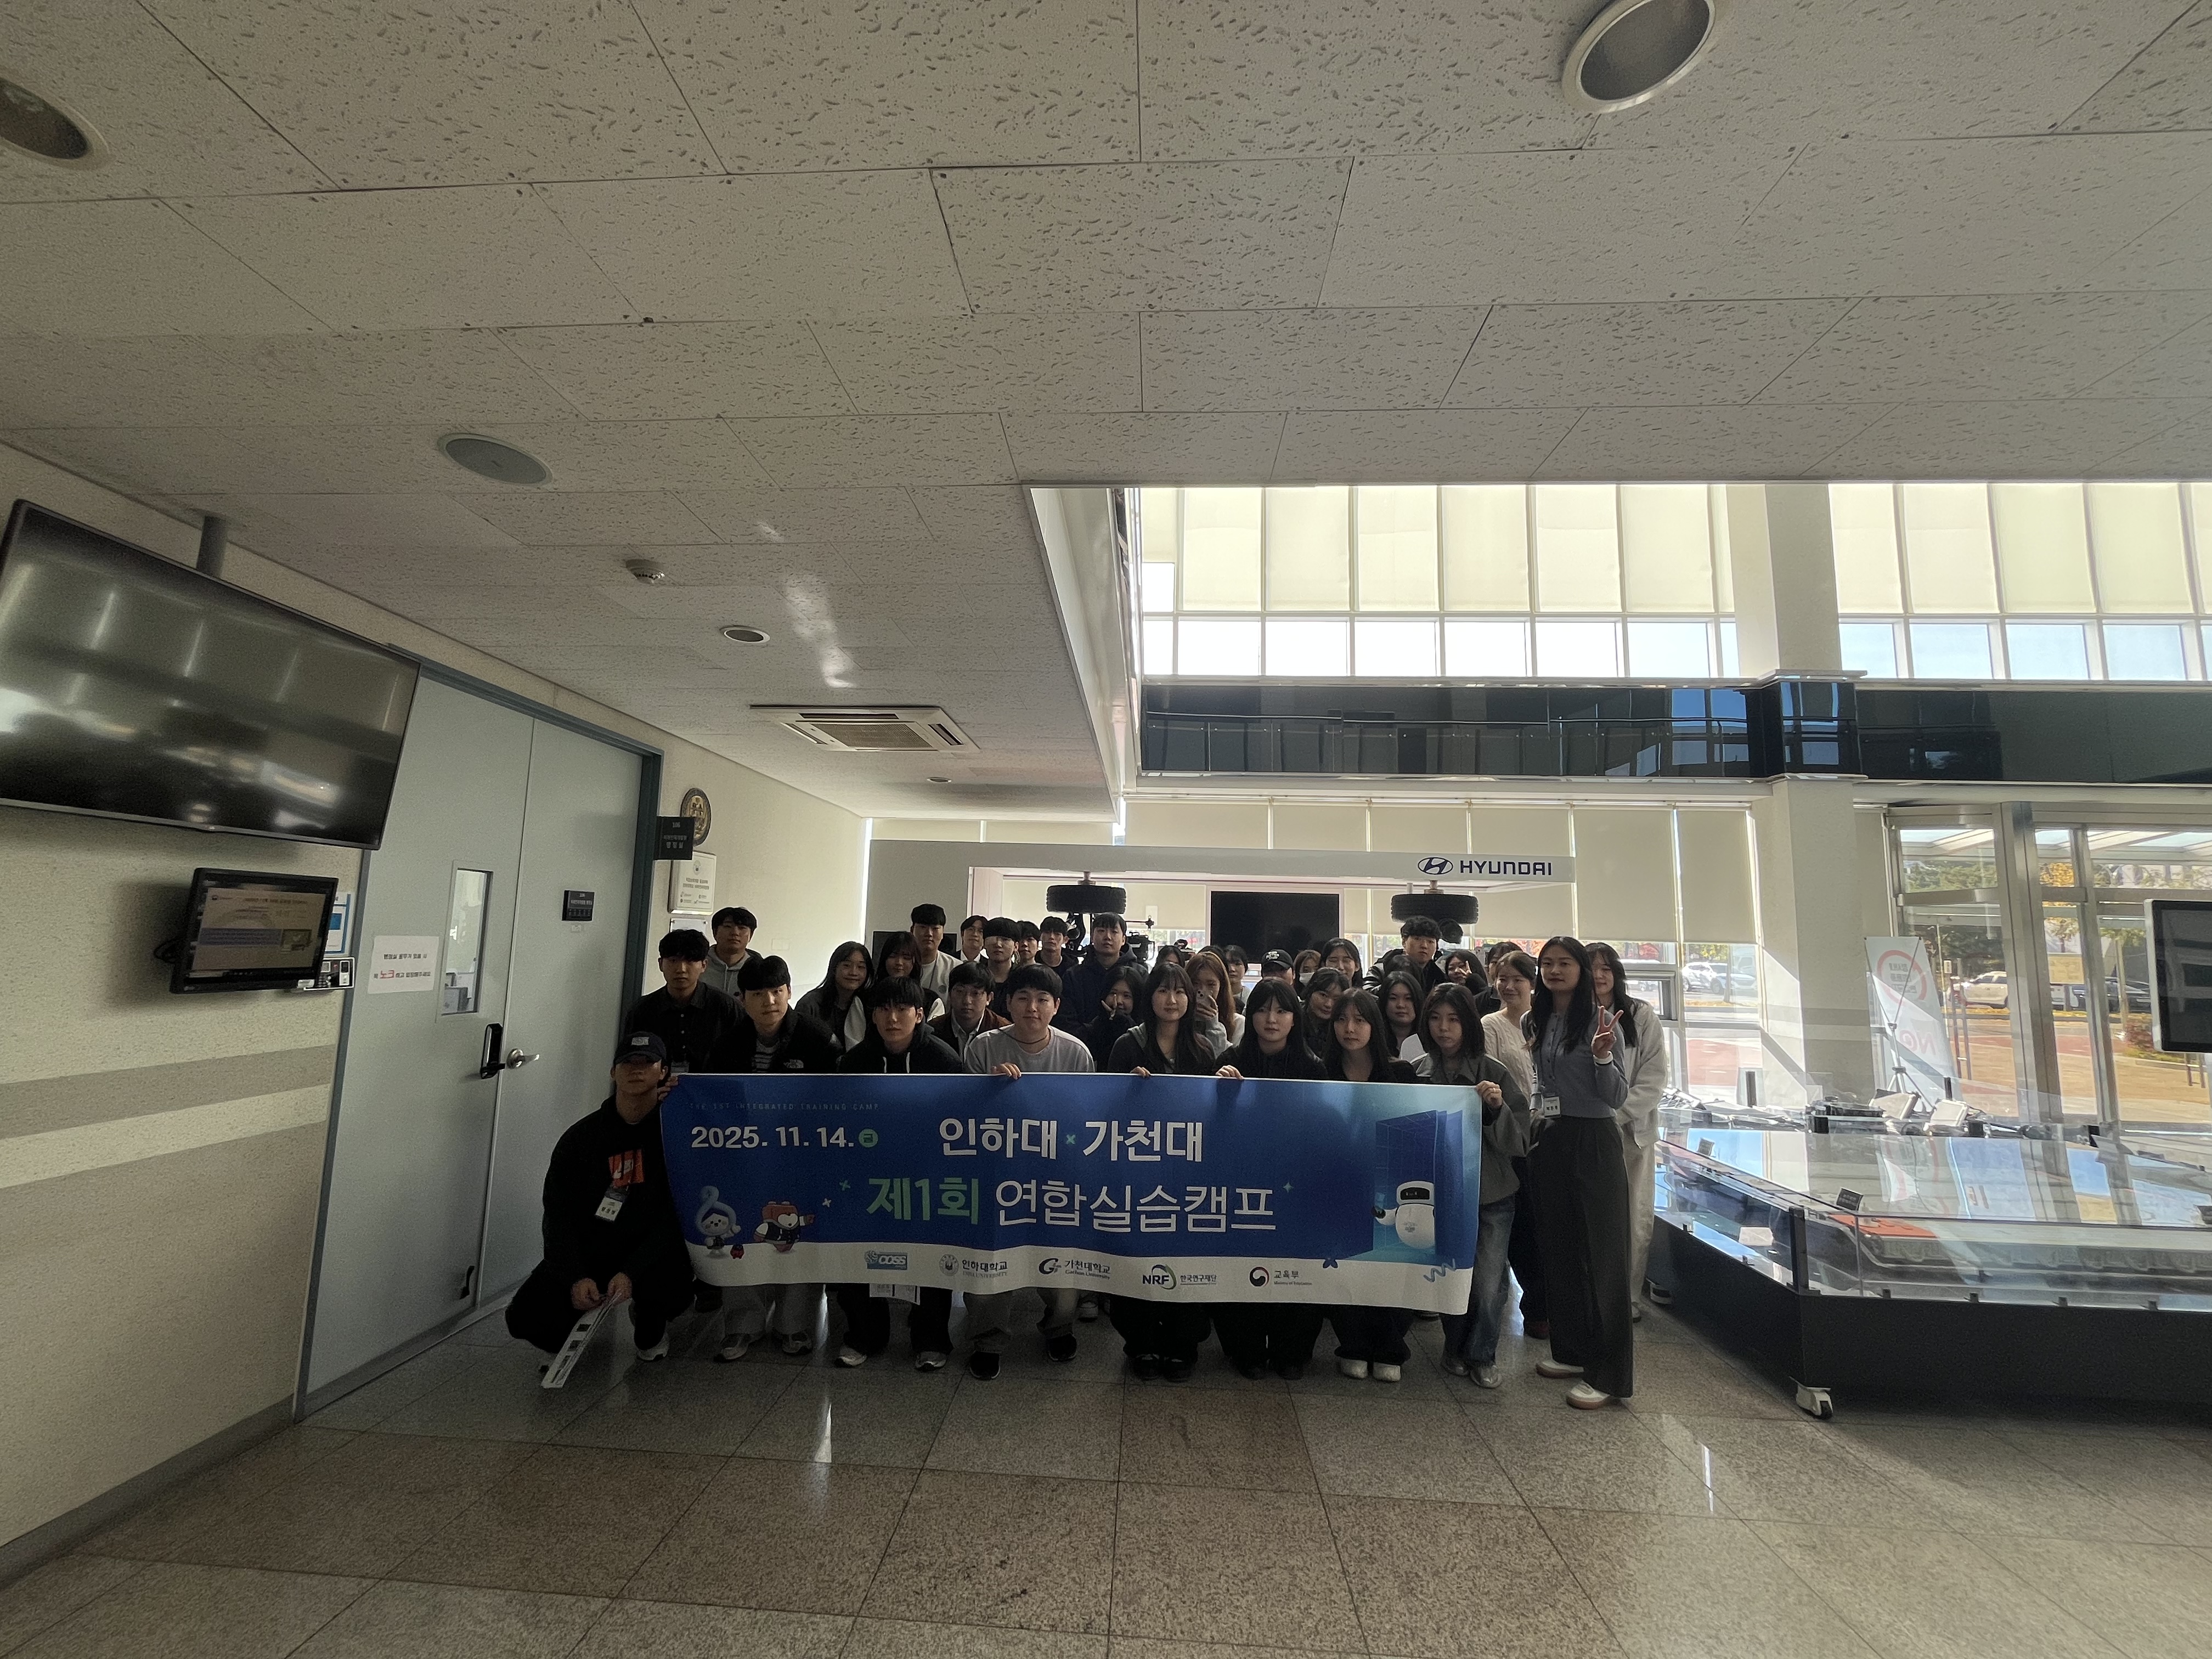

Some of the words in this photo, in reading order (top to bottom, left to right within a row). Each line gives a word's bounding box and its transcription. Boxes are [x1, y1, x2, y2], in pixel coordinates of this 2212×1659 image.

[1460, 860, 1551, 876] HYUNDAI
[691, 1126, 768, 1148] 2025.
[775, 1126, 809, 1147] 11.
[816, 1127, 854, 1148] 14.
[939, 1118, 1057, 1160] 인하대
[1082, 1120, 1203, 1162] 가천대
[866, 1176, 979, 1225] 제1회
[962, 1259, 1008, 1272] 인하대학교
[1064, 1259, 1110, 1274] 가천대학교
[1142, 1274, 1170, 1285] NRF
[1180, 1274, 1217, 1283] 한국연구재단
[1273, 1270, 1300, 1279] 교육부
